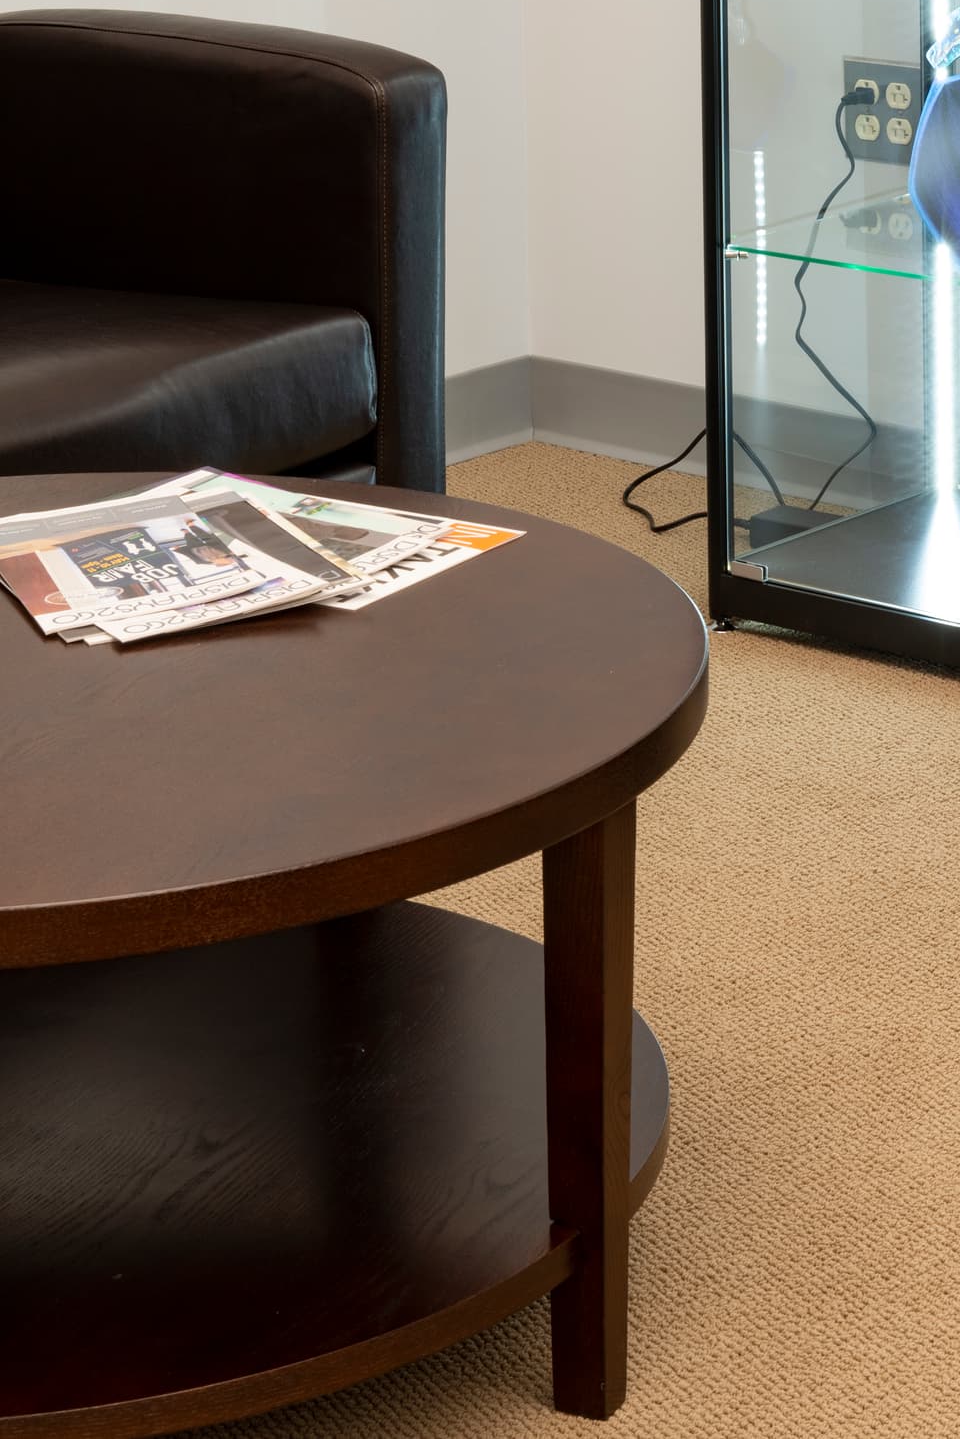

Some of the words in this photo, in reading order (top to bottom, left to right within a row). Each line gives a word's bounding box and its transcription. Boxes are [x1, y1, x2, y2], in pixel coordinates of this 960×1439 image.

[92, 559, 154, 583] FAIR
[130, 563, 179, 583] JOB
[51, 576, 251, 625] DISPLAYS2GO
[122, 578, 312, 635] DISPLAYS2GO
